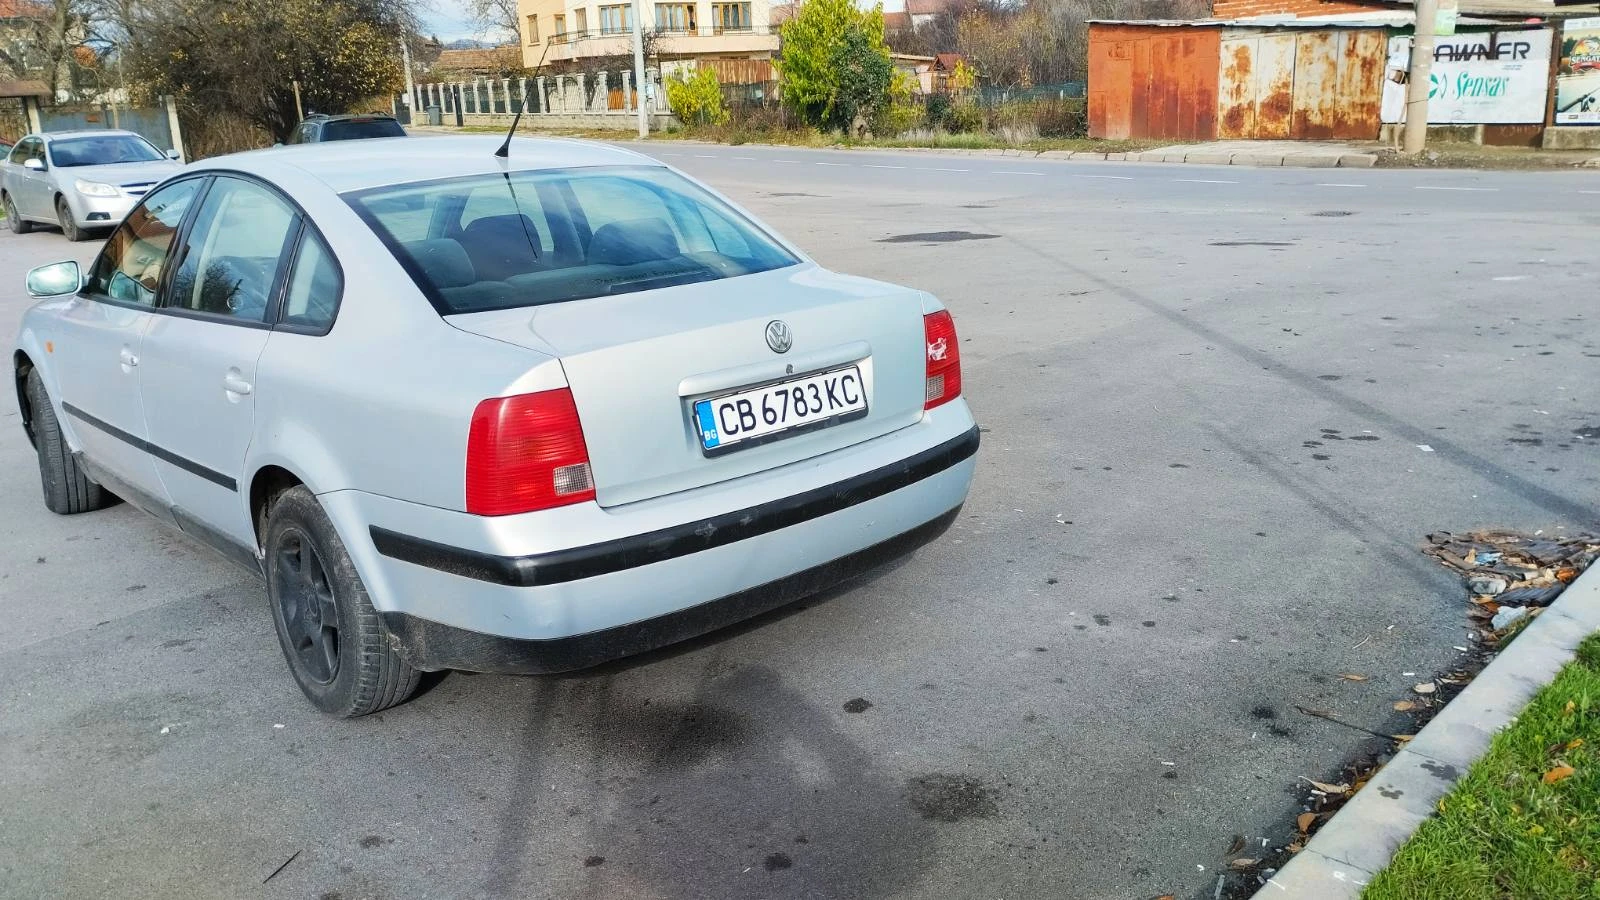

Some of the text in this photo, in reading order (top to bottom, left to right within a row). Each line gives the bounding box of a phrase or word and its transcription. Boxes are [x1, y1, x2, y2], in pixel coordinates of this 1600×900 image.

[1456, 71, 1510, 100] Sensas
[719, 375, 859, 436] CB 6783 KC
[704, 430, 717, 441] BG
